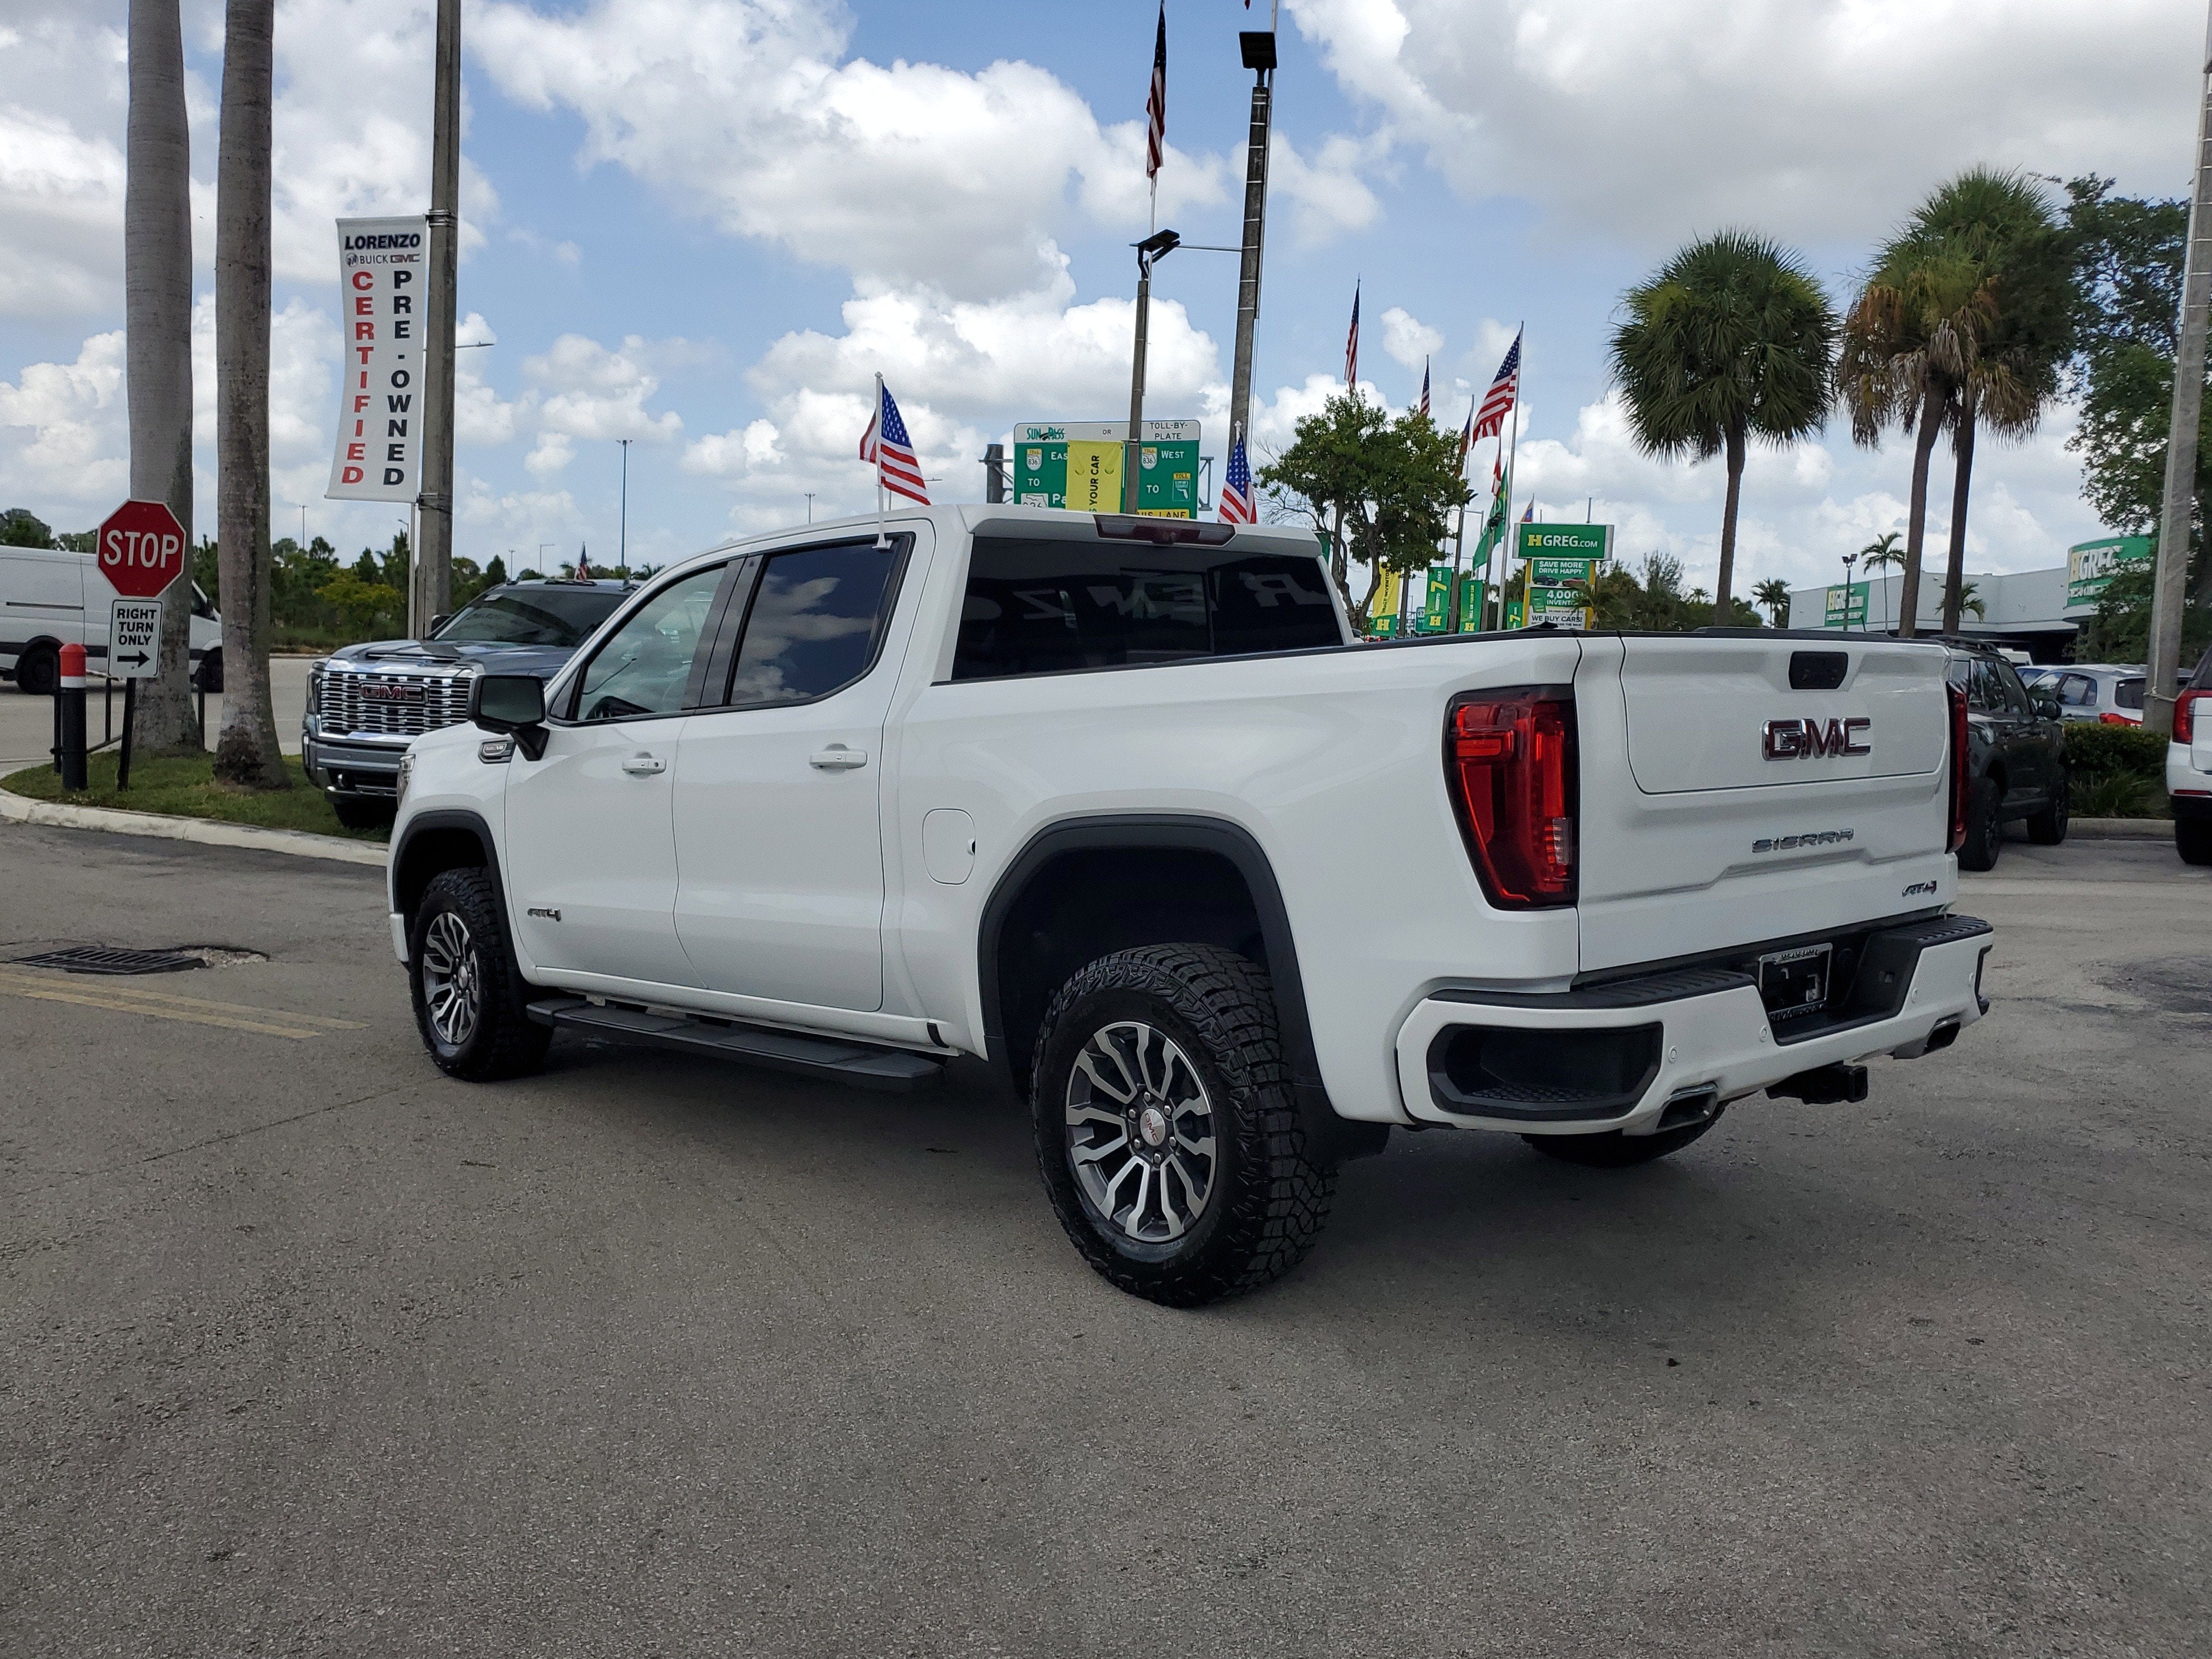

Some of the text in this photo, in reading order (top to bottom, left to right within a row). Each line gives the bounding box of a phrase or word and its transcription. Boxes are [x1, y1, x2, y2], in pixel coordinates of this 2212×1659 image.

[345, 233, 421, 250] LORENZO
[359, 253, 420, 264] BUICK GMC
[341, 271, 374, 484] CERTIFIED
[1149, 422, 1188, 430] TOLL-BY-
[1051, 452, 1068, 460] EAS
[1161, 450, 1184, 459] WEST
[1090, 455, 1099, 475] CAR
[1089, 478, 1099, 506] YOUR
[1146, 485, 1159, 493] TO
[104, 529, 179, 568] STOP
[1430, 581, 1447, 592] 7
[117, 608, 157, 620] RIGHT
[119, 622, 154, 633] TURN
[118, 634, 152, 646] ONLY
[361, 685, 421, 700] GMC
[1761, 717, 1871, 761] GMC
[1752, 828, 1854, 853] SIERRA
[1901, 881, 1937, 897] AT4
[527, 908, 562, 922] AT4
[1144, 1113, 1159, 1143] GMC
